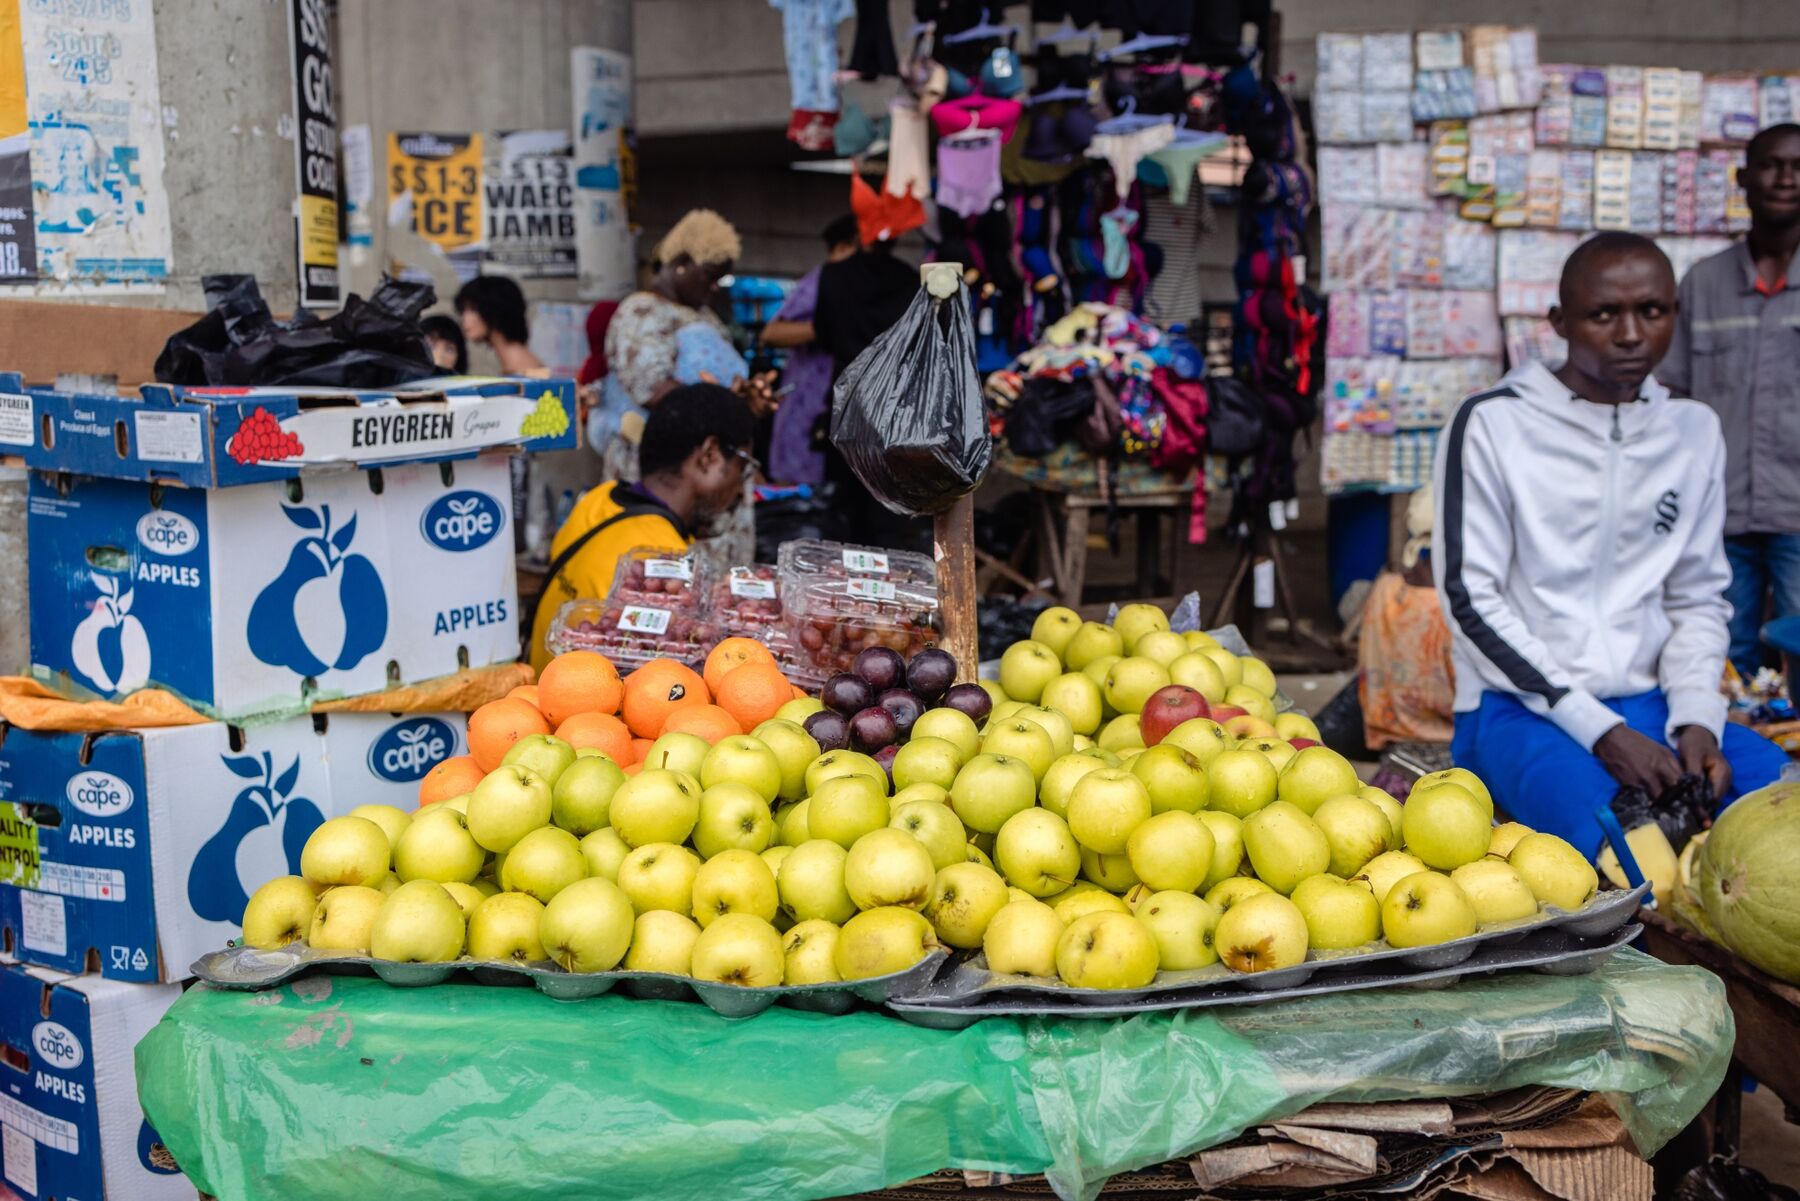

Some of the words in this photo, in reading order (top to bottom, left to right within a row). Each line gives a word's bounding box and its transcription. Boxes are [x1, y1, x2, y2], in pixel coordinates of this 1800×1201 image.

[489, 213, 574, 238] JAMB
[351, 411, 455, 448] EGYGREEN
[463, 410, 501, 438] Grapes
[147, 526, 188, 549] cape
[435, 511, 493, 545] cape
[137, 561, 201, 588] APPLES
[433, 599, 507, 636] APPLES
[383, 737, 446, 774] cape
[77, 788, 121, 810] cape
[69, 823, 136, 849] APPLES
[40, 1037, 74, 1061] cape
[35, 1070, 86, 1104] APPLES
